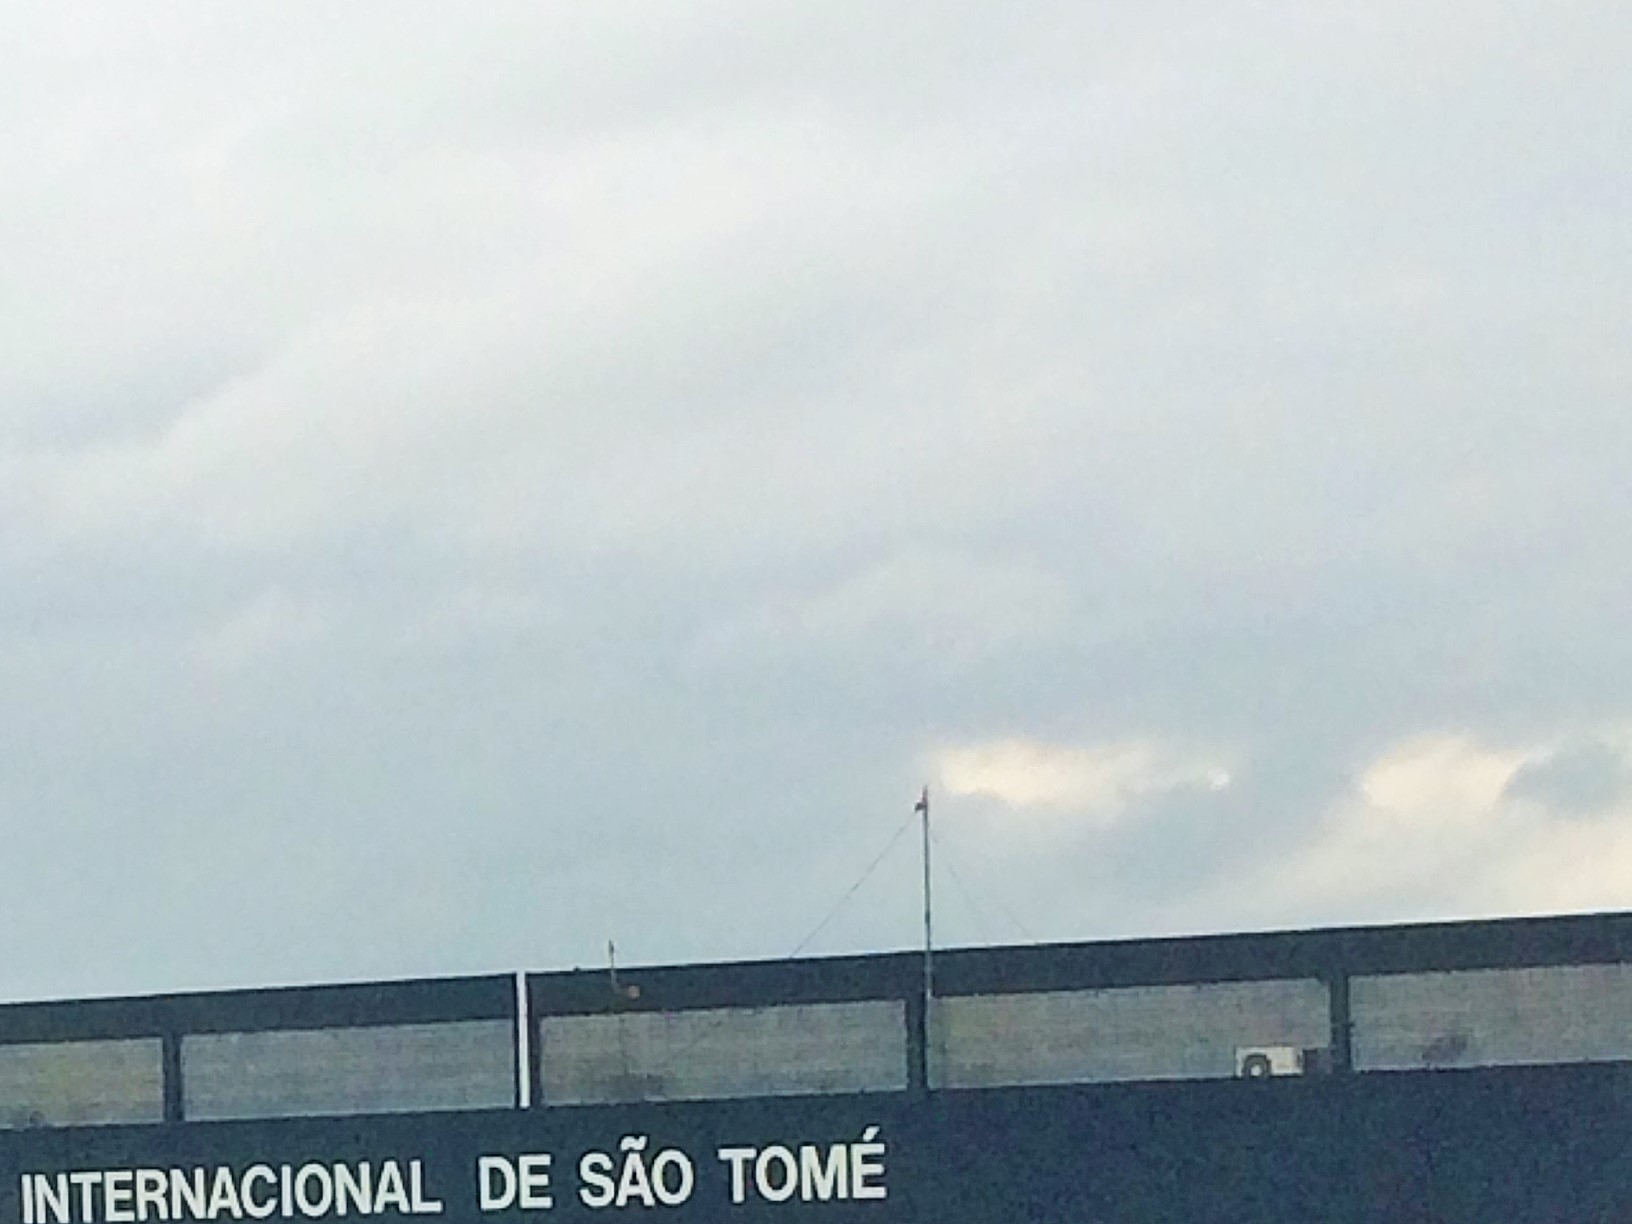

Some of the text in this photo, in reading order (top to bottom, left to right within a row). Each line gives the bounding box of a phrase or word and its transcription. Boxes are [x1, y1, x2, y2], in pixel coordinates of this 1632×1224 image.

[478, 1153, 554, 1212] DE
[579, 1134, 695, 1208] SÃO
[717, 1125, 888, 1205] TOMÉ
